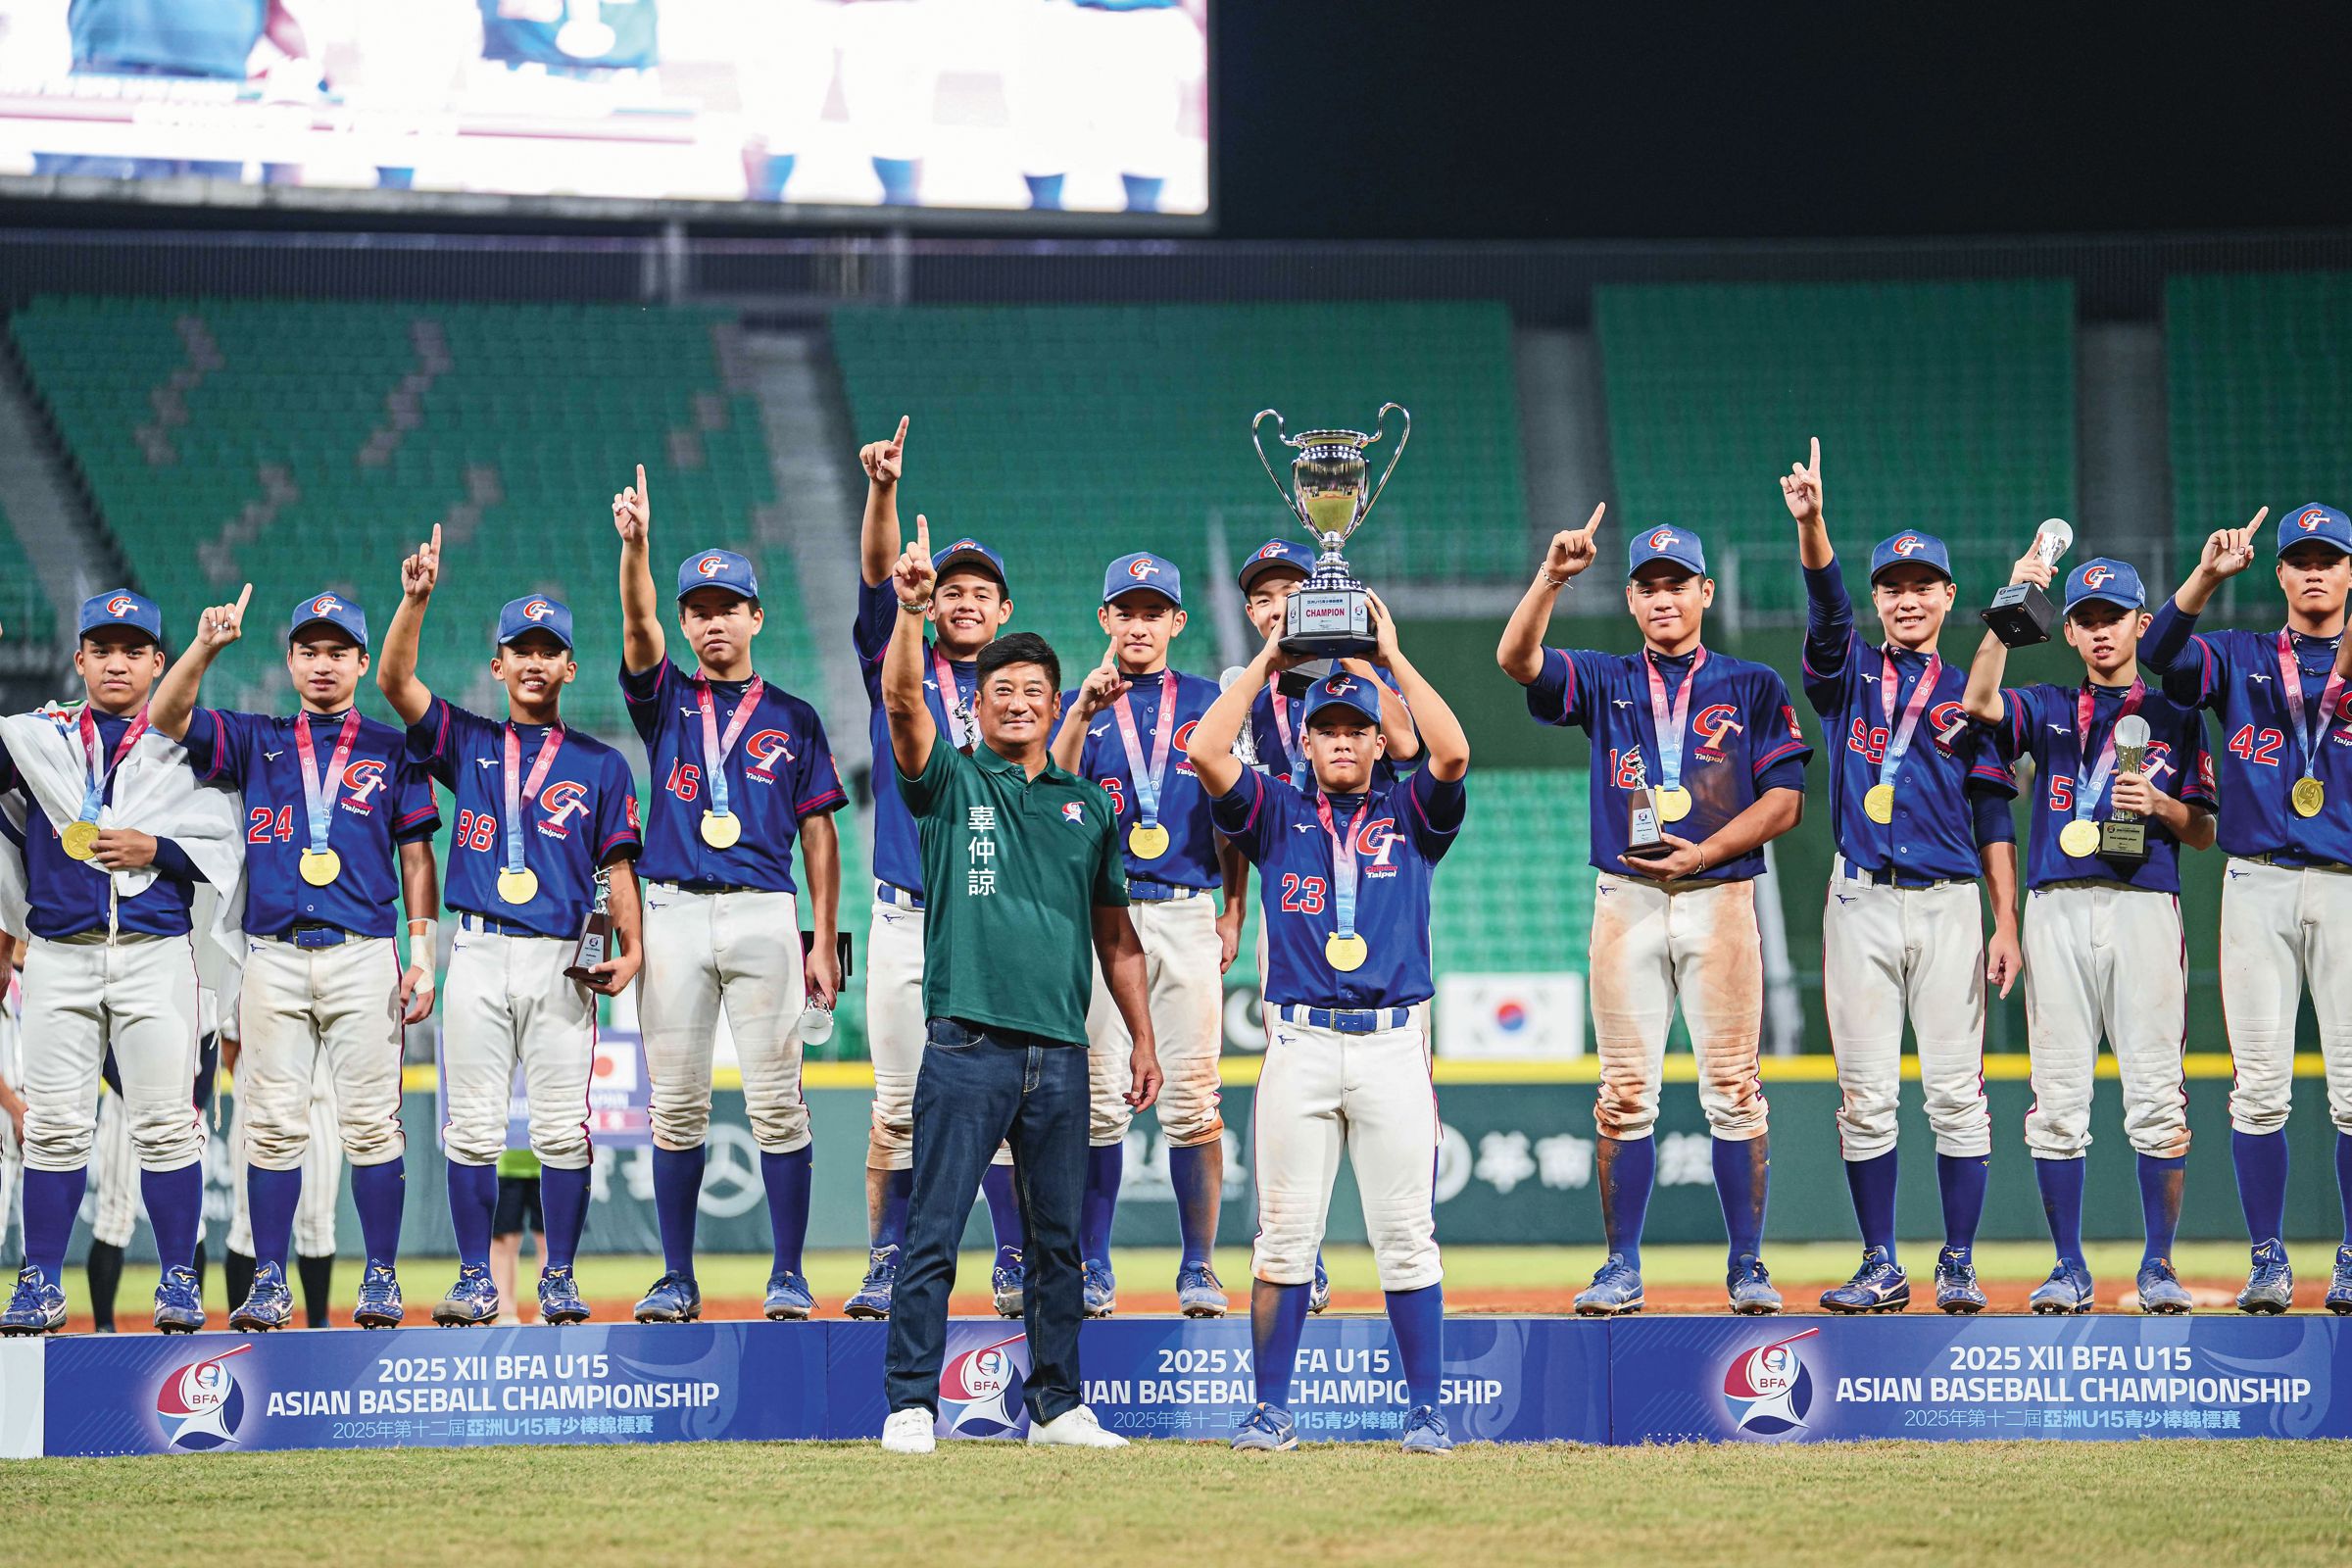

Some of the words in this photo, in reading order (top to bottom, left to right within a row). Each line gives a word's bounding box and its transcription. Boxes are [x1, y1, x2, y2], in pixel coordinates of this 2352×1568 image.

[1306, 609, 1345, 617] CHAMPION
[1848, 717, 1889, 764] 99
[2229, 724, 2283, 766] 42
[665, 757, 701, 802] 16
[1176, 768, 1199, 777] Taipe
[1610, 748, 1638, 789] 18
[2050, 775, 2074, 811] 5
[248, 805, 293, 844] 24
[458, 808, 497, 852] 98
[968, 806, 996, 896] 辜仲諒
[1282, 873, 1326, 914] 23
[591, 1092, 629, 1108] APAN
[378, 1358, 447, 1383] 2025
[453, 1356, 487, 1381] XII
[496, 1356, 547, 1381] BFA
[555, 1354, 609, 1379] U15
[1158, 1349, 1226, 1373] 2025
[1295, 1349, 1329, 1372] FA
[1335, 1349, 1390, 1373] U15
[1950, 1347, 2020, 1370] 2025
[2029, 1347, 2064, 1369] XII
[2073, 1347, 2126, 1369] BFA
[2134, 1347, 2191, 1370] U15
[973, 1381, 1001, 1391] BFA
[1080, 1381, 1131, 1403] IAN
[1139, 1380, 1257, 1403] BASEBAL
[1287, 1380, 1502, 1403] CHAMPIOSHIP
[1759, 1378, 1788, 1388] BFA
[1836, 1378, 1923, 1402] ASIAN
[1931, 1378, 2075, 1402] BASEBALL
[2081, 1378, 2311, 1403] CHAMPIONSHIP
[192, 1395, 220, 1404] BFA
[267, 1390, 351, 1417] ASIAN
[360, 1387, 496, 1413] BASEBALL
[503, 1383, 720, 1411] CHAMPIONSHIP
